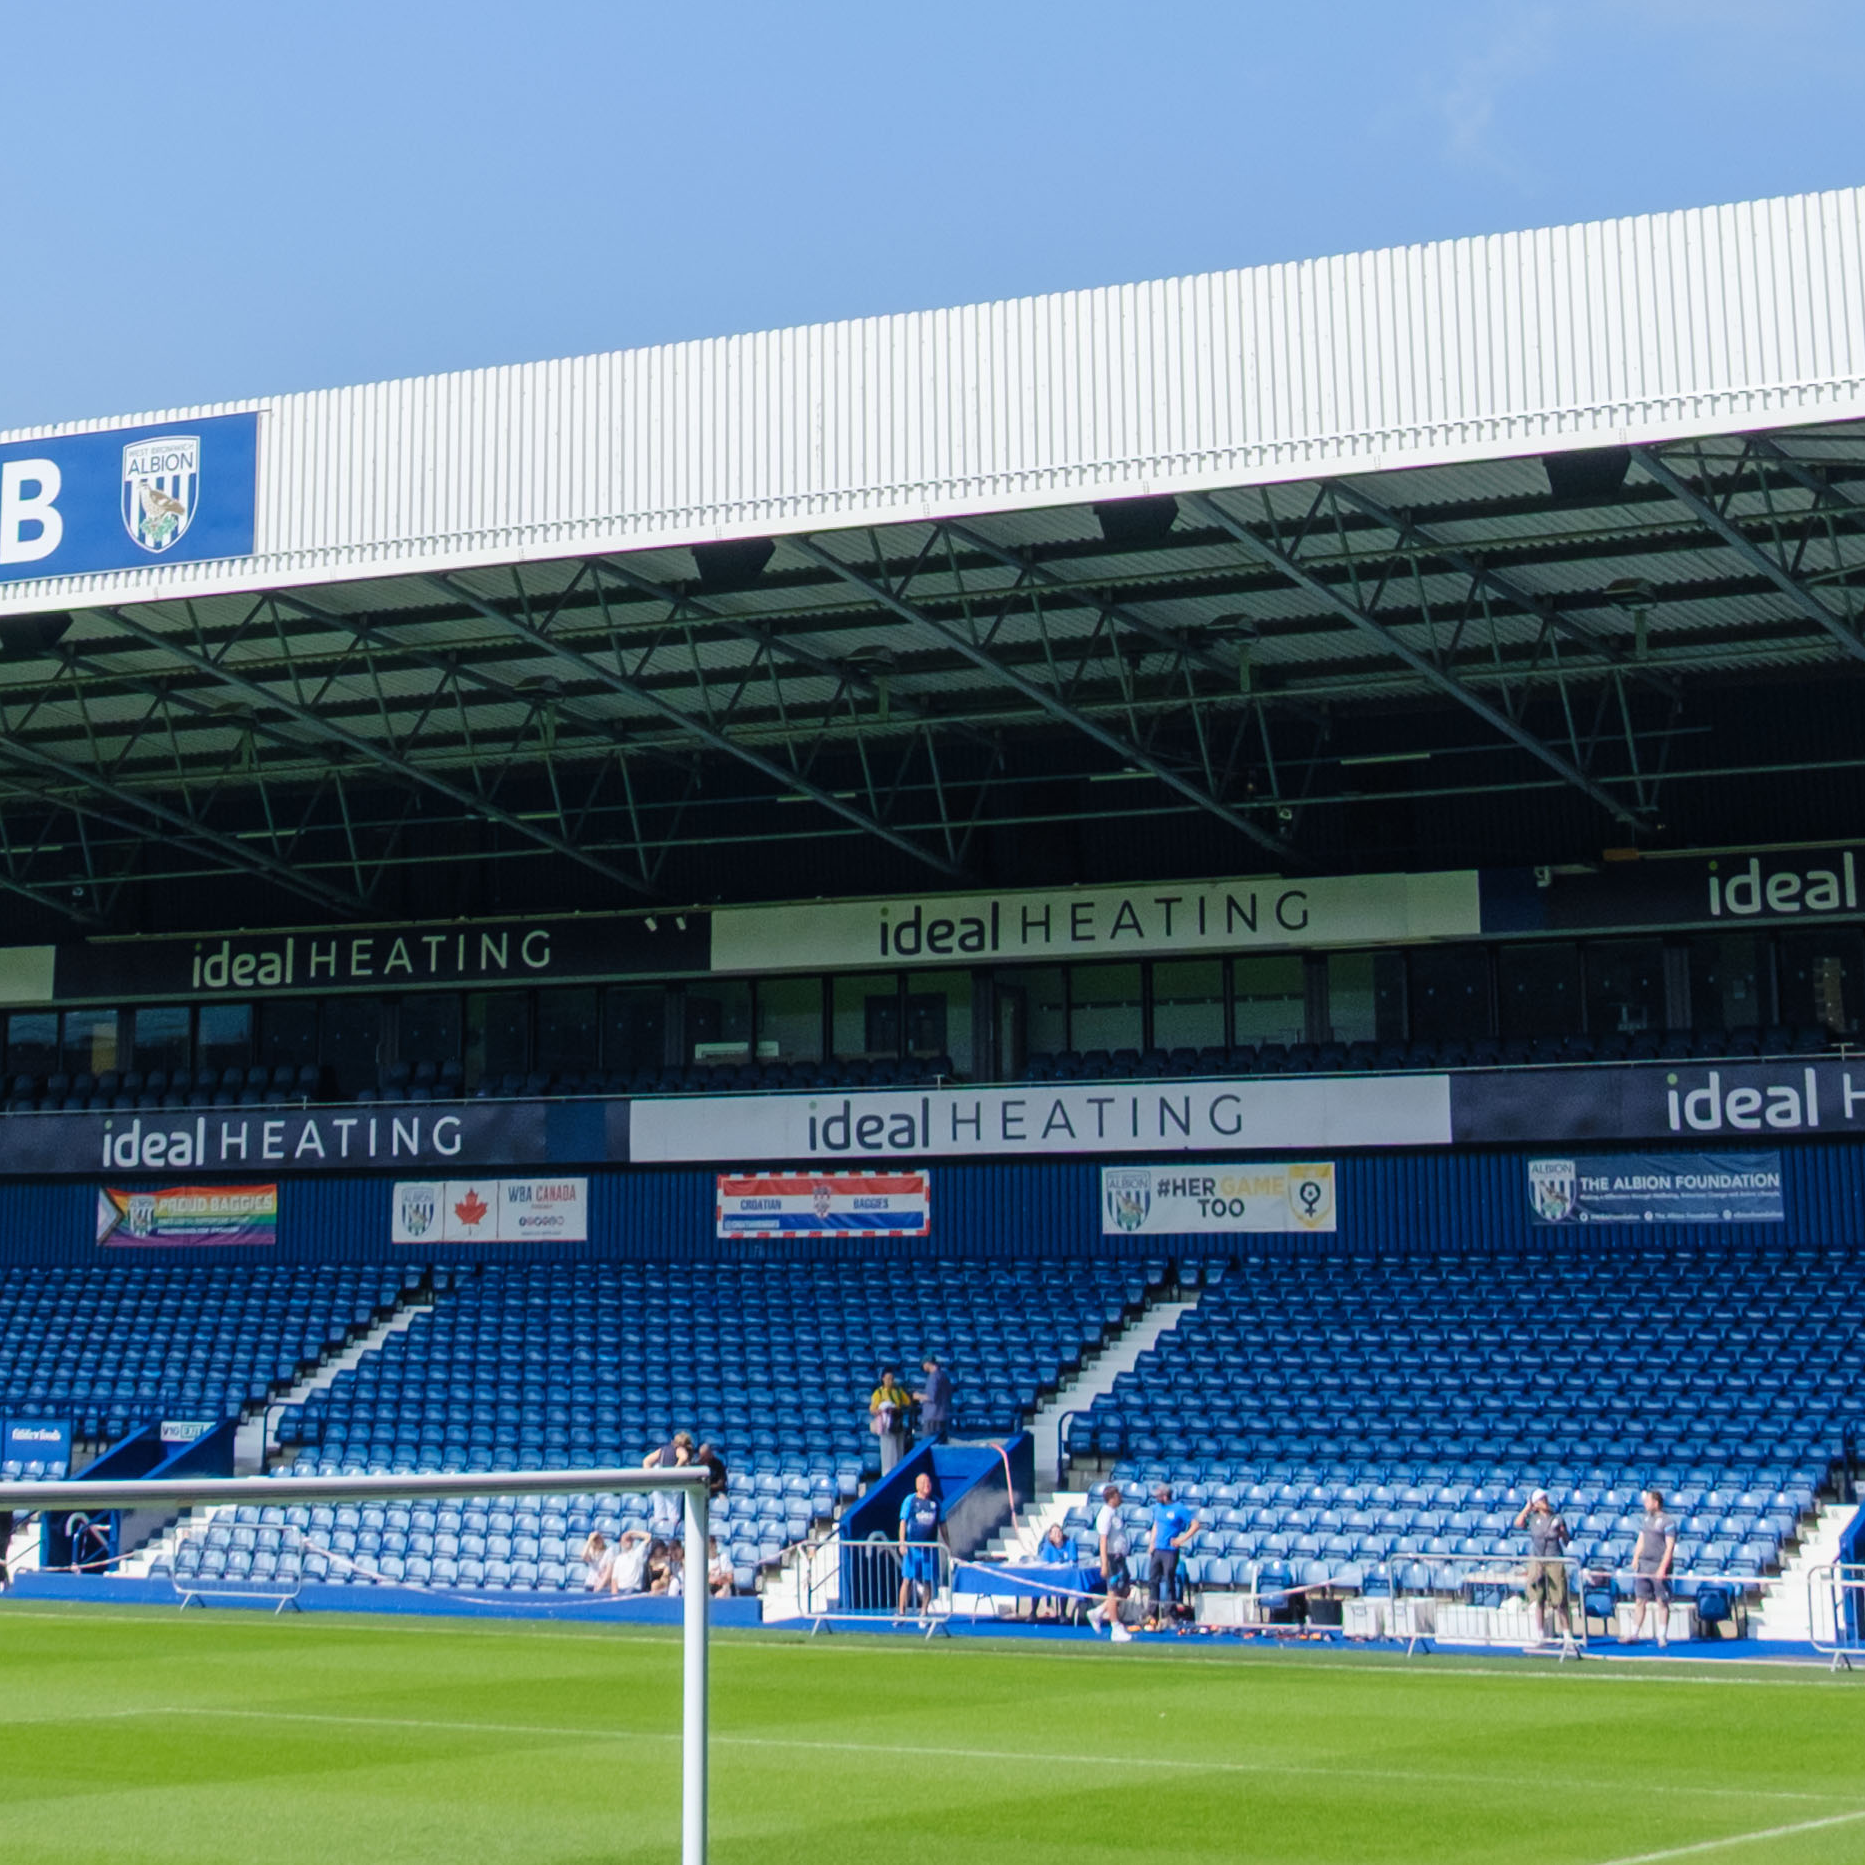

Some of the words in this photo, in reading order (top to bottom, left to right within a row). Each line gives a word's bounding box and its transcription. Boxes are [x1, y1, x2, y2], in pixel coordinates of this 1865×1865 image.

[128, 451, 194, 476] ALBION
[1708, 851, 1856, 916] ideal
[880, 901, 1000, 957] ideal
[1021, 889, 1310, 945] HEATING
[193, 937, 293, 989] ideal
[310, 930, 551, 977] HEATING
[1666, 1068, 1819, 1132] ideal
[809, 1097, 930, 1151] ideal
[952, 1094, 1243, 1142] HEATING
[102, 1116, 204, 1169] ideal
[221, 1116, 463, 1162] HEATING
[1531, 1163, 1573, 1175] ALBION
[508, 1186, 532, 1203] WBA
[535, 1184, 577, 1202] CANADA
[1157, 1178, 1216, 1198] #HER
[1221, 1176, 1284, 1196] GAME
[1580, 1177, 1609, 1191] THE
[1613, 1176, 1672, 1191] ALBION
[1675, 1173, 1781, 1189] FOUNDATION
[157, 1196, 208, 1214] PROUD
[210, 1194, 273, 1212] BAGGIES
[740, 1198, 783, 1211] CROATIAN
[853, 1197, 889, 1210] BAGGIES
[1198, 1198, 1245, 1218] TOO
